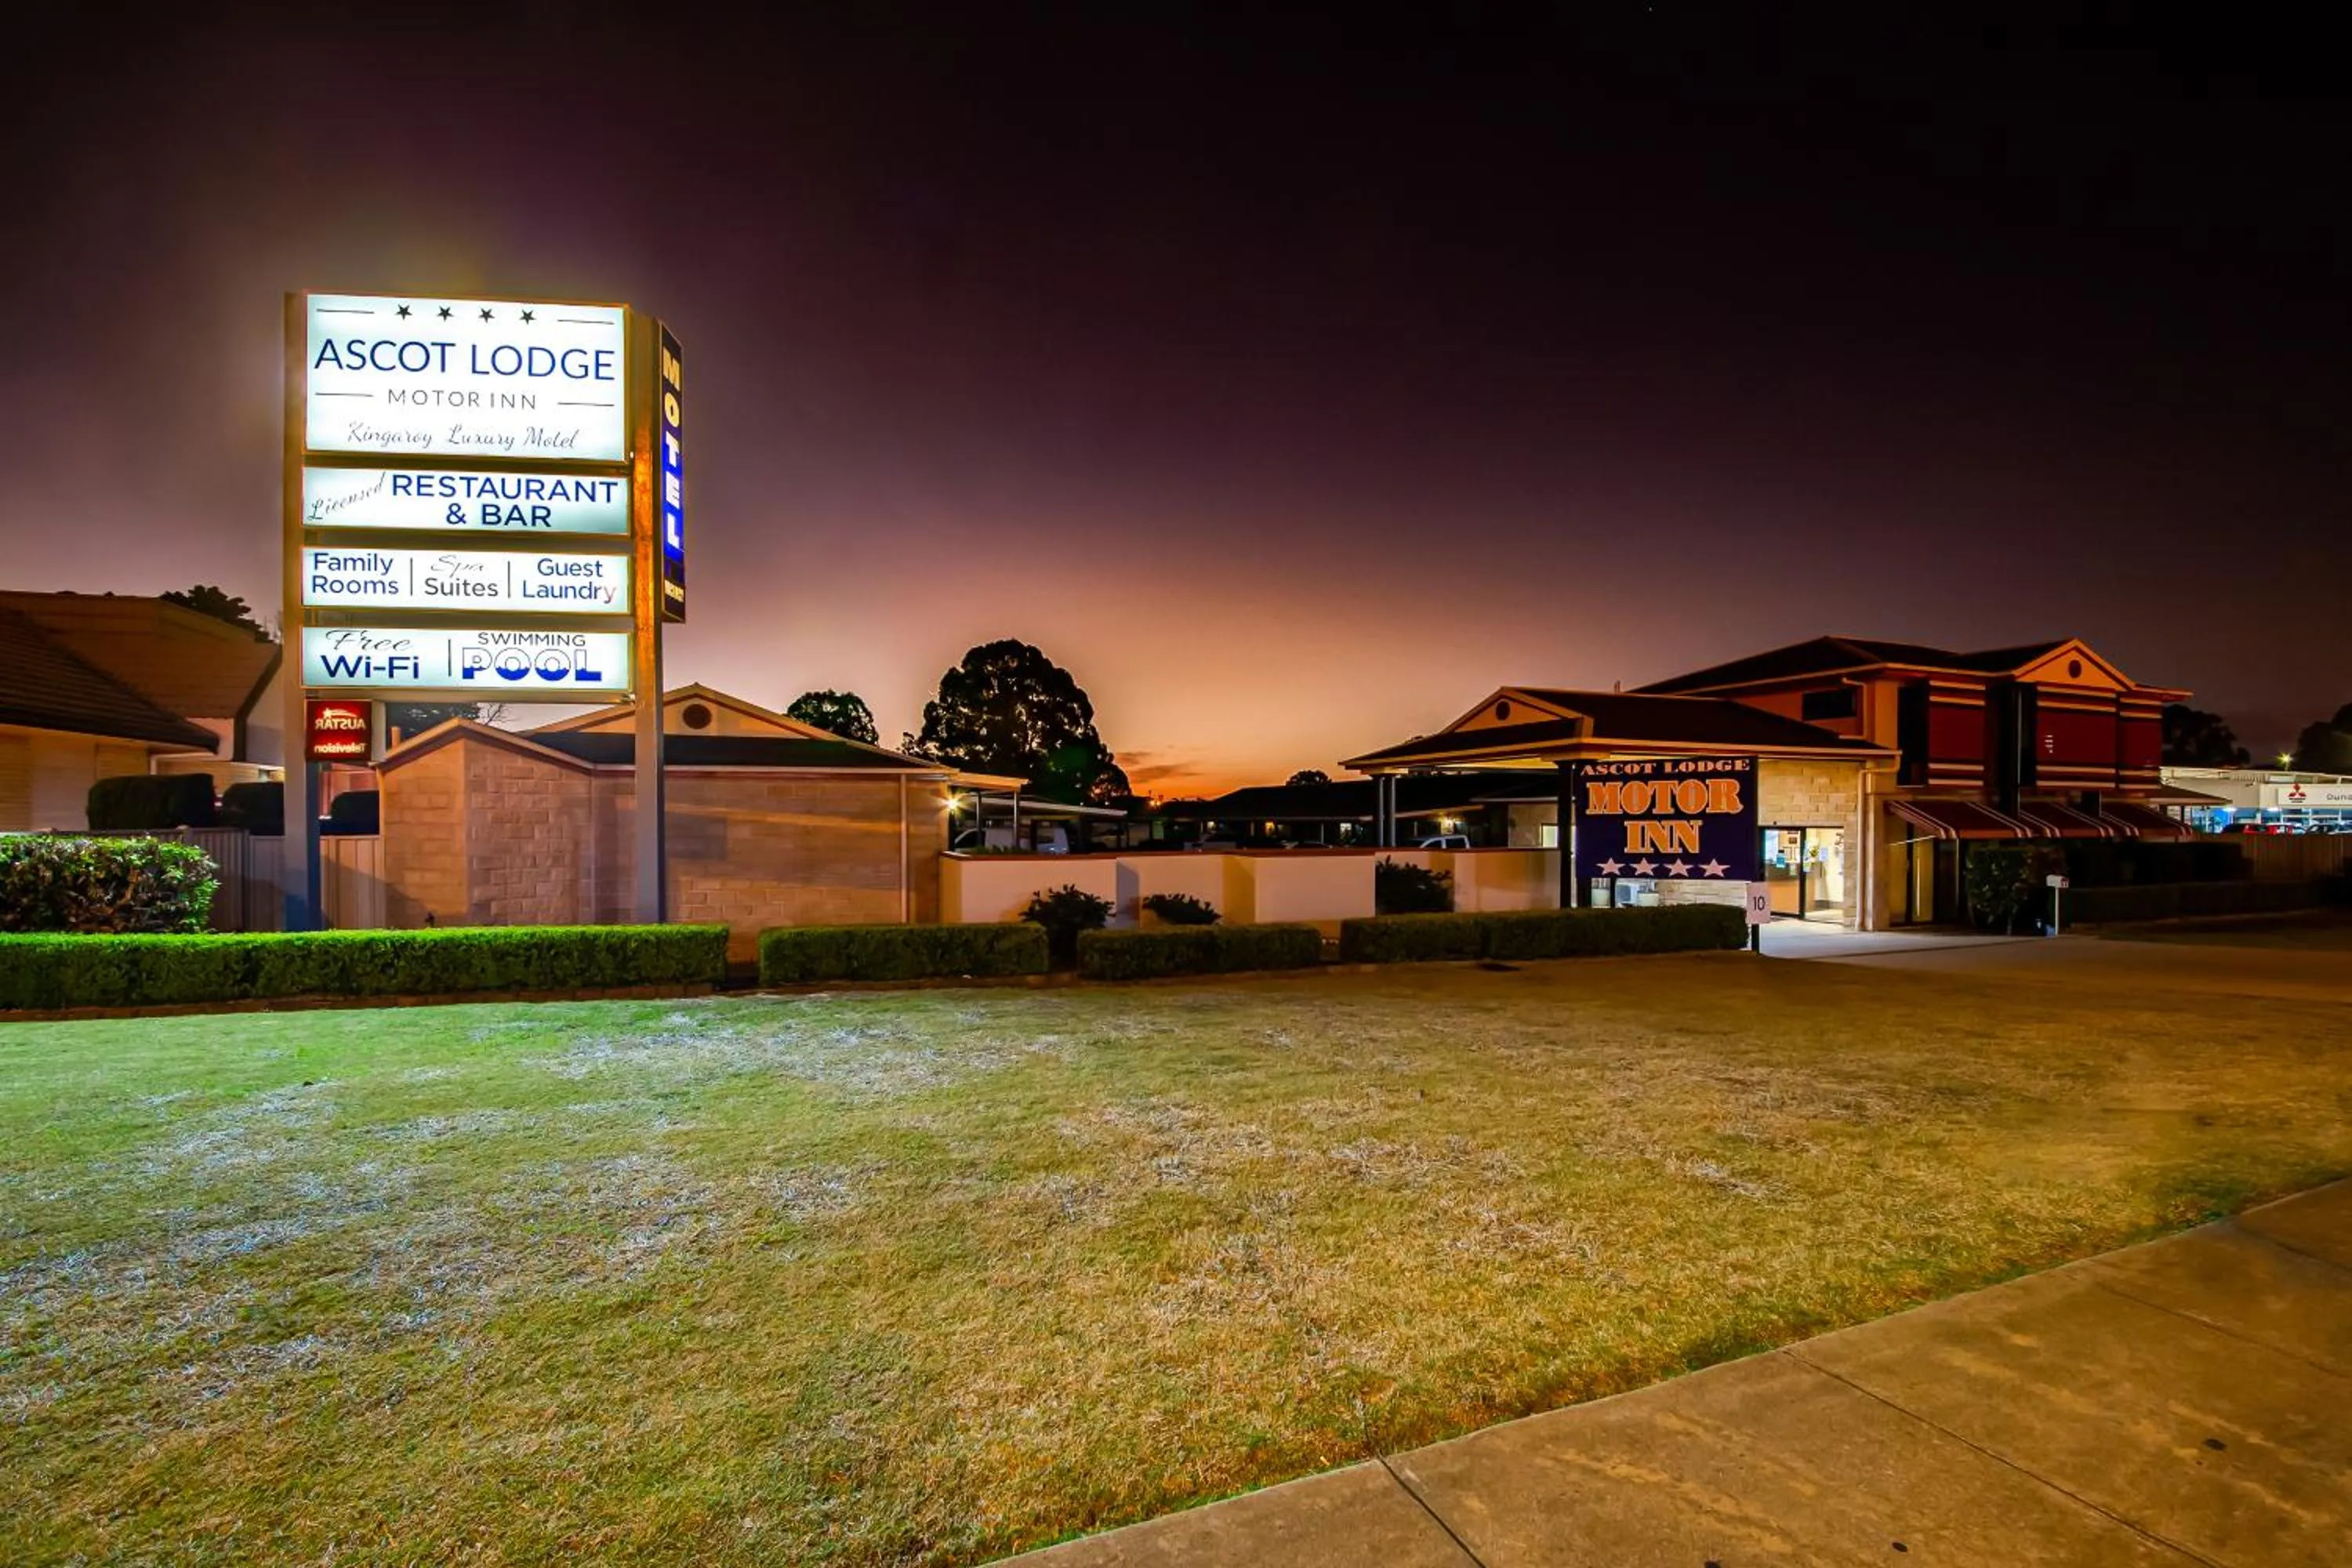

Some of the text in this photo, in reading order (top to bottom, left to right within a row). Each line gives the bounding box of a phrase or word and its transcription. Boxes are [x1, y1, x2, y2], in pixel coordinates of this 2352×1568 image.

[314, 338, 615, 381] ASCOT LODGE
[388, 389, 537, 410] MOTOR INN
[347, 421, 581, 451] Kingaroy Luxury Motel
[663, 347, 681, 549] MOTEL
[308, 472, 387, 521] Licensed
[392, 474, 619, 503] RESTAURANT
[446, 503, 553, 527] & BAR
[314, 552, 394, 575] Family
[430, 554, 485, 578] Spa
[537, 559, 603, 578] Guest
[312, 576, 399, 596] Rooms
[424, 579, 499, 597] Suites
[523, 582, 616, 604] Laundry
[325, 630, 412, 652] Free
[477, 632, 586, 647] SWIMMING
[321, 655, 419, 679] Wi-Fi
[462, 647, 602, 681] POOL
[1581, 759, 1750, 776] ASCOT LODGE
[1585, 779, 1744, 815] MOTOR
[1624, 819, 1703, 854] INN
[1753, 896, 1766, 911] 10
